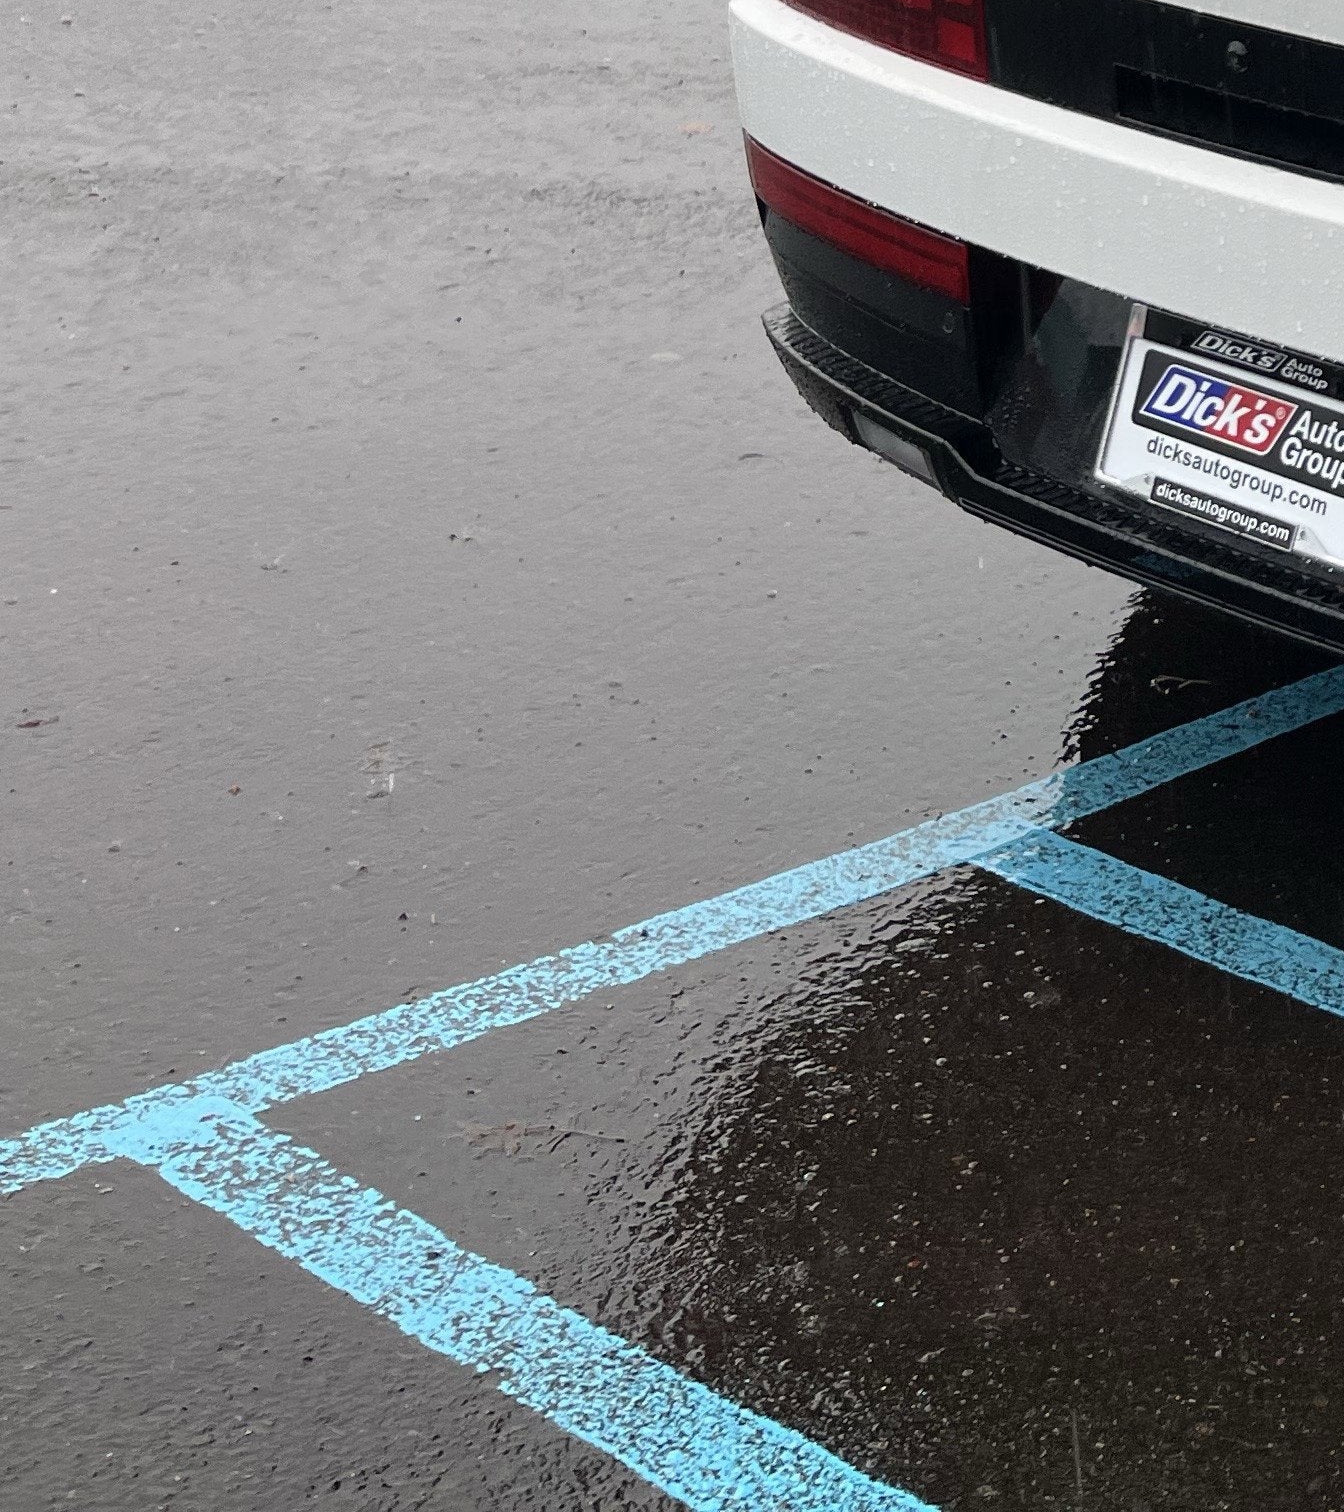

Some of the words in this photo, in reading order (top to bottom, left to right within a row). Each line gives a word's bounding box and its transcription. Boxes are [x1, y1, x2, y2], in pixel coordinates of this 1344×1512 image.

[1198, 334, 1277, 368] Dick's
[1287, 357, 1324, 377] Auto
[1280, 365, 1329, 391] Group
[1152, 373, 1277, 445] Dick's
[1146, 436, 1329, 517] dicksautogroup.com
[1156, 482, 1291, 542] dicksautogroup.com
